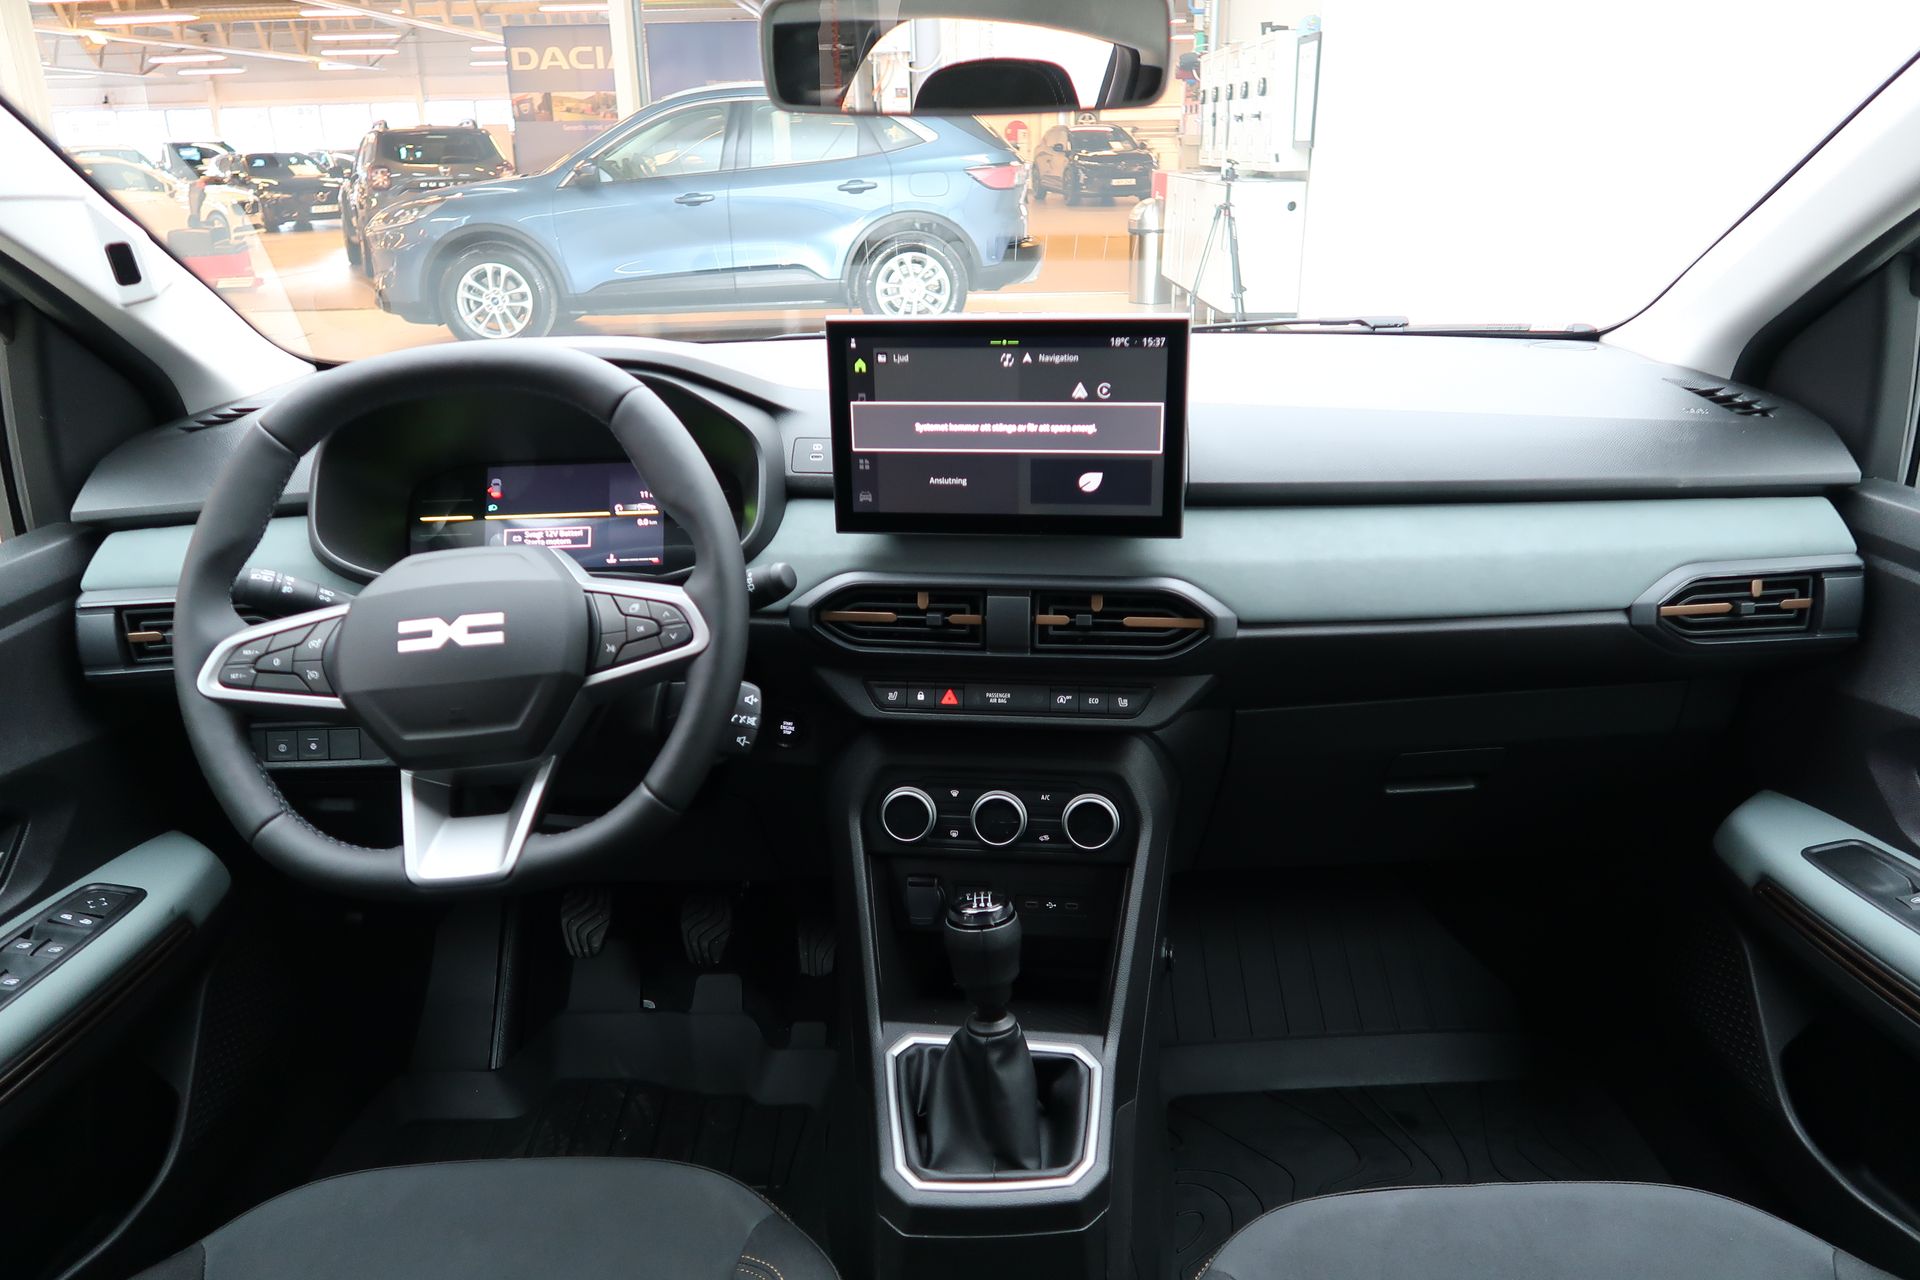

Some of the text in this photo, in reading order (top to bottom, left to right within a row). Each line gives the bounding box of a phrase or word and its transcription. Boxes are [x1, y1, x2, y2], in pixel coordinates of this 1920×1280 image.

[510, 46, 614, 70] DACI
[1142, 336, 1166, 347] 15:37
[893, 353, 909, 364] Ljud
[1039, 353, 1079, 364] Navigation
[914, 422, 948, 434] Systemet
[949, 422, 979, 433] kommer
[929, 476, 967, 487] Anslutning
[1088, 697, 1099, 705] ECO
